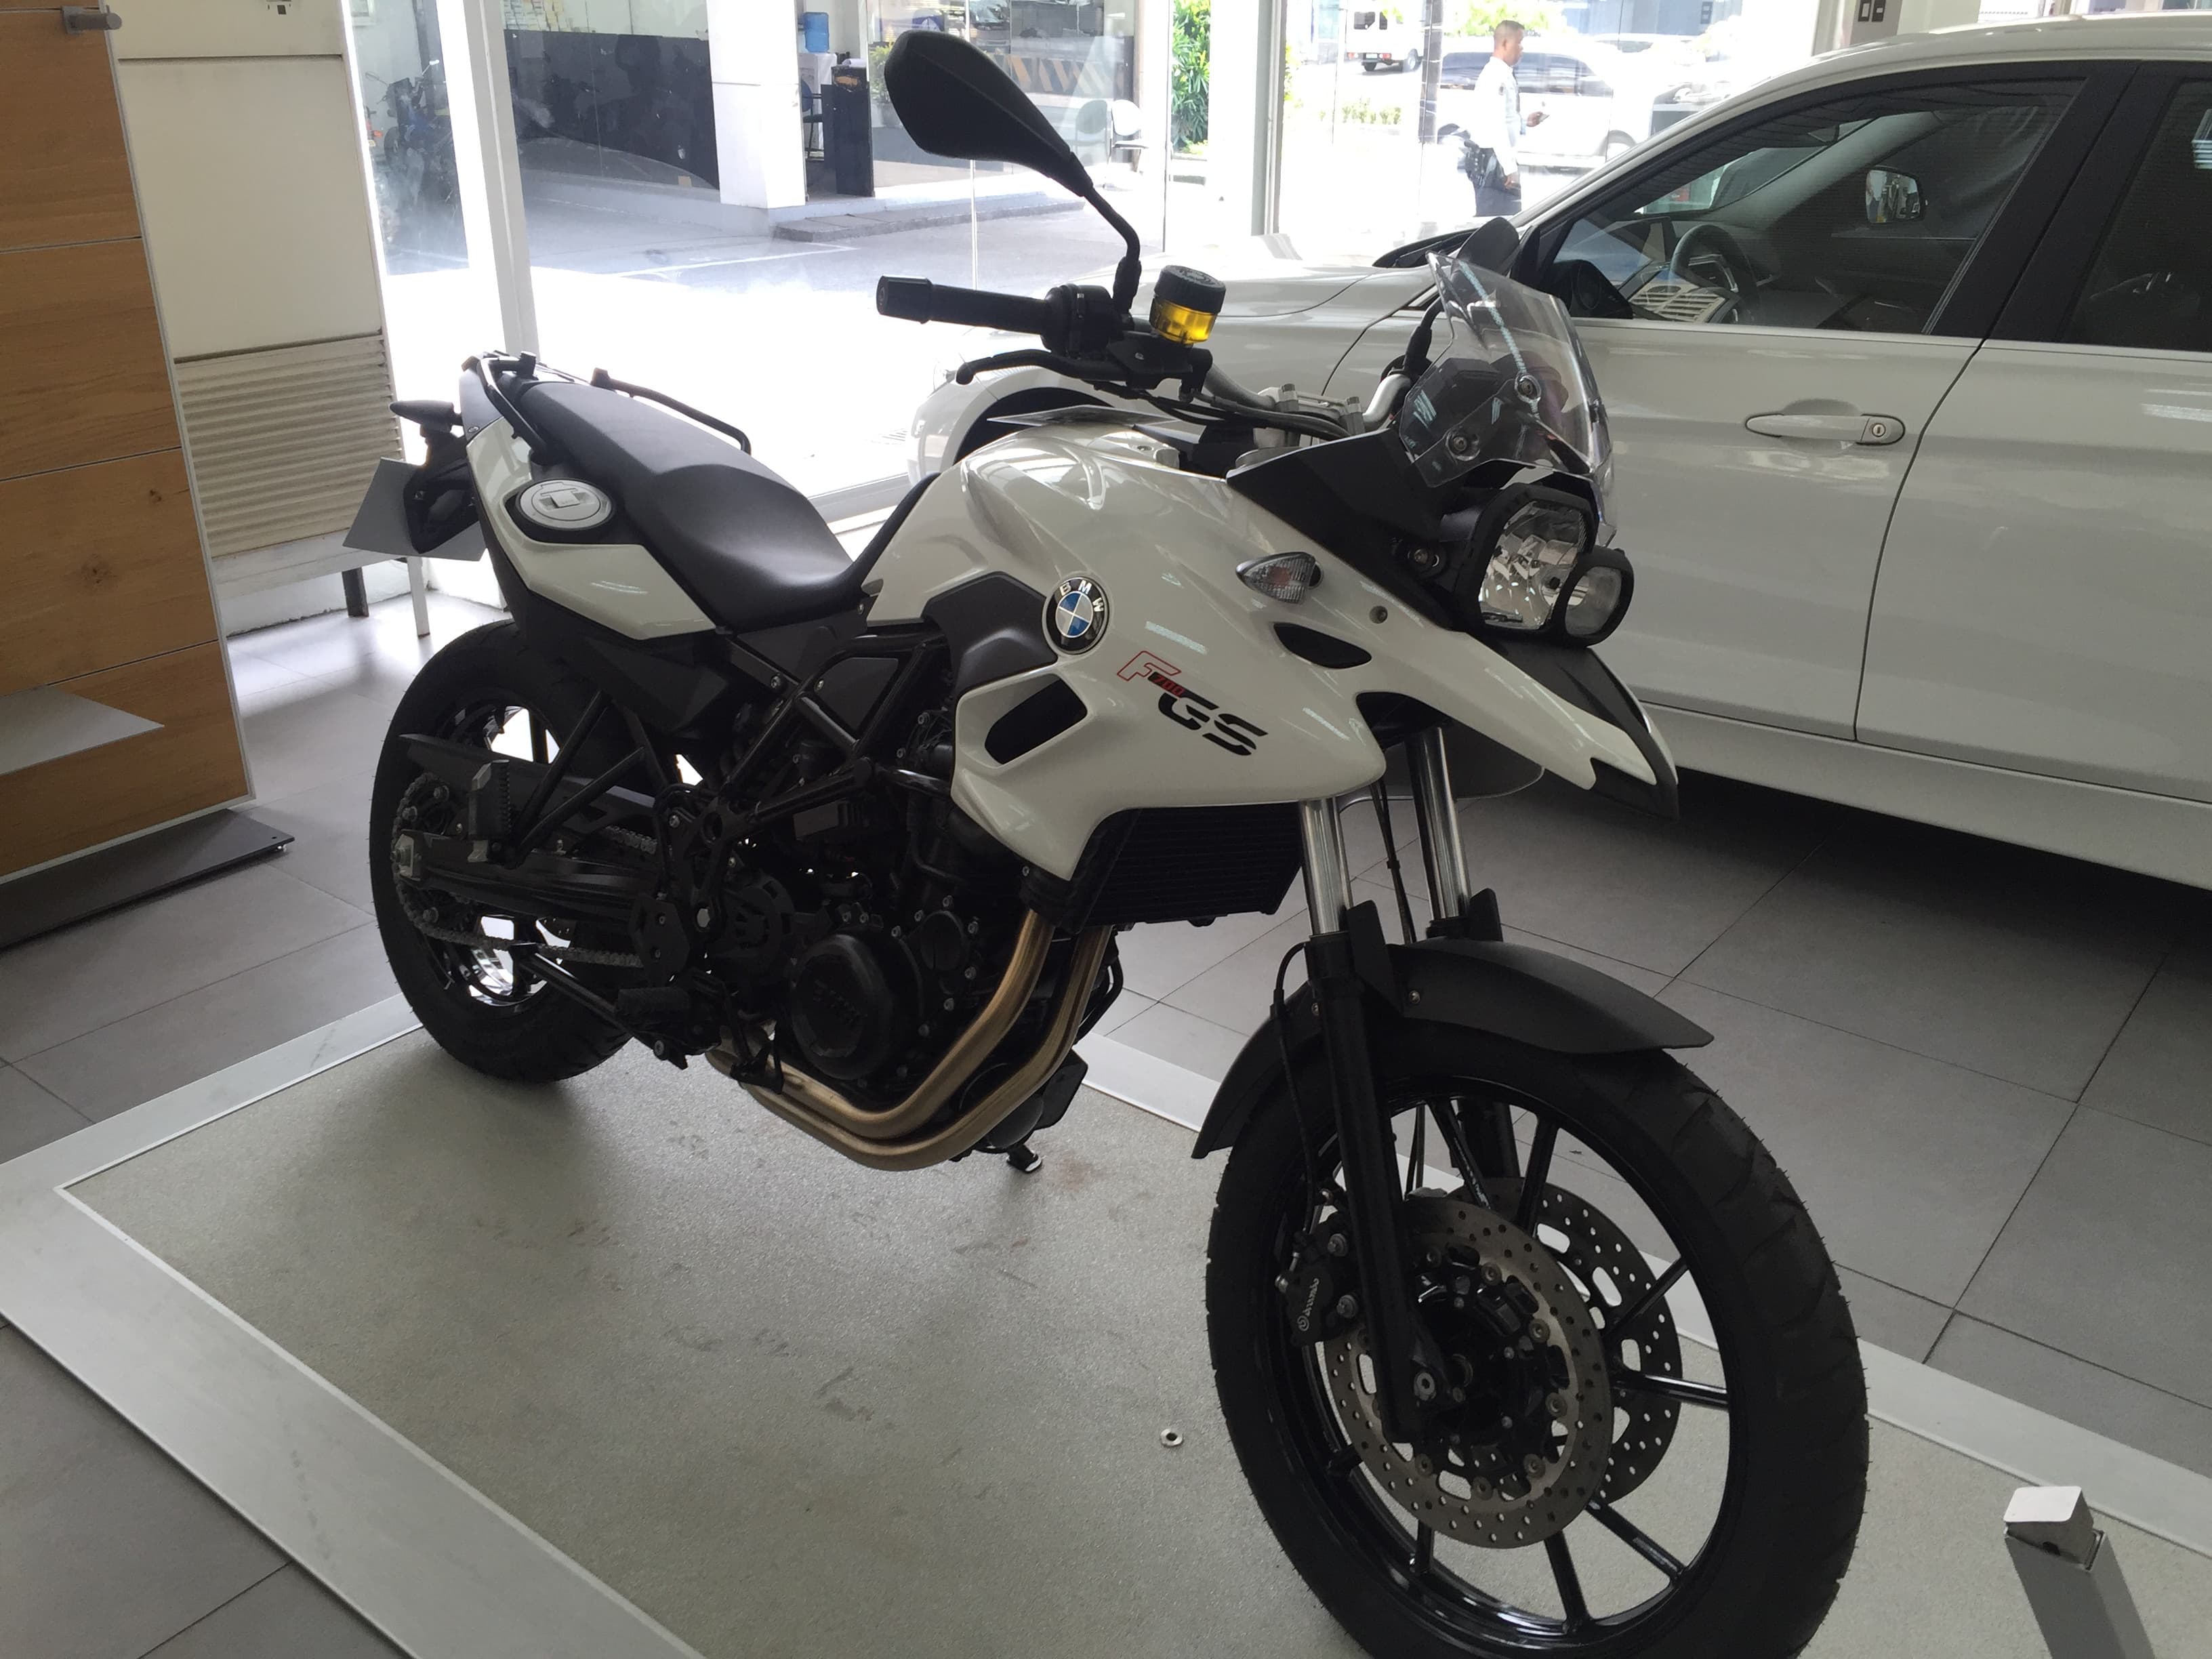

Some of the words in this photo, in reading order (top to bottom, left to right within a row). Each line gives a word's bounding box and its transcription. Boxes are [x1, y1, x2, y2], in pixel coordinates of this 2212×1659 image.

[1059, 580, 1105, 613] BMW
[1116, 650, 1182, 682] F
[1152, 673, 1186, 698] 700
[1158, 686, 1269, 756] GS
